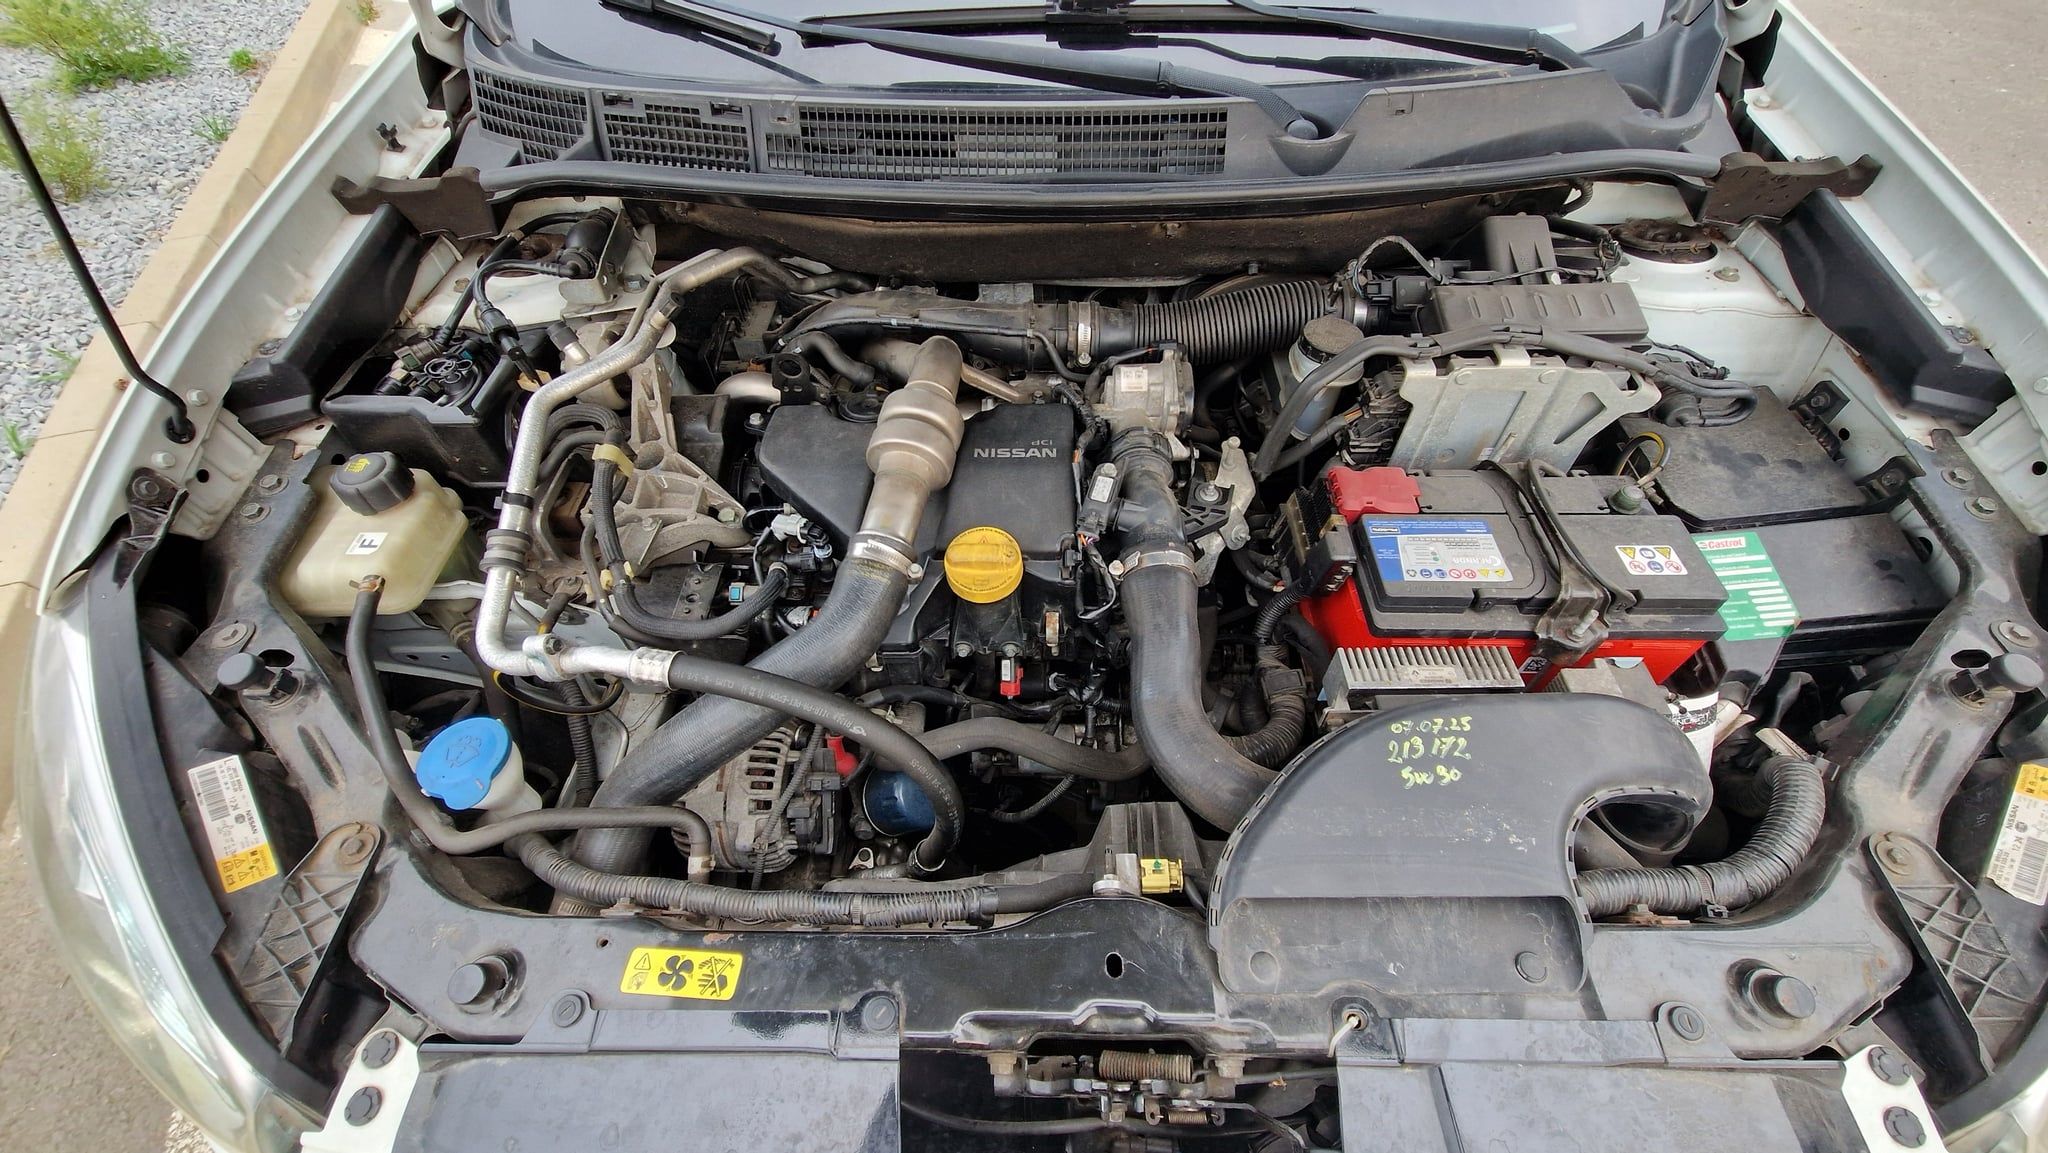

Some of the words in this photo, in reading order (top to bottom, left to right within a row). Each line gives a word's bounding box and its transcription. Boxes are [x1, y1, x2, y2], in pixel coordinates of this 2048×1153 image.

[973, 447, 1057, 458] NISSAN
[358, 538, 378, 549] F
[1708, 538, 1743, 550] Castrol
[1391, 716, 1473, 735] 07.07.25
[245, 809, 259, 835] NISSAN
[2005, 804, 2019, 830] NISSAN
